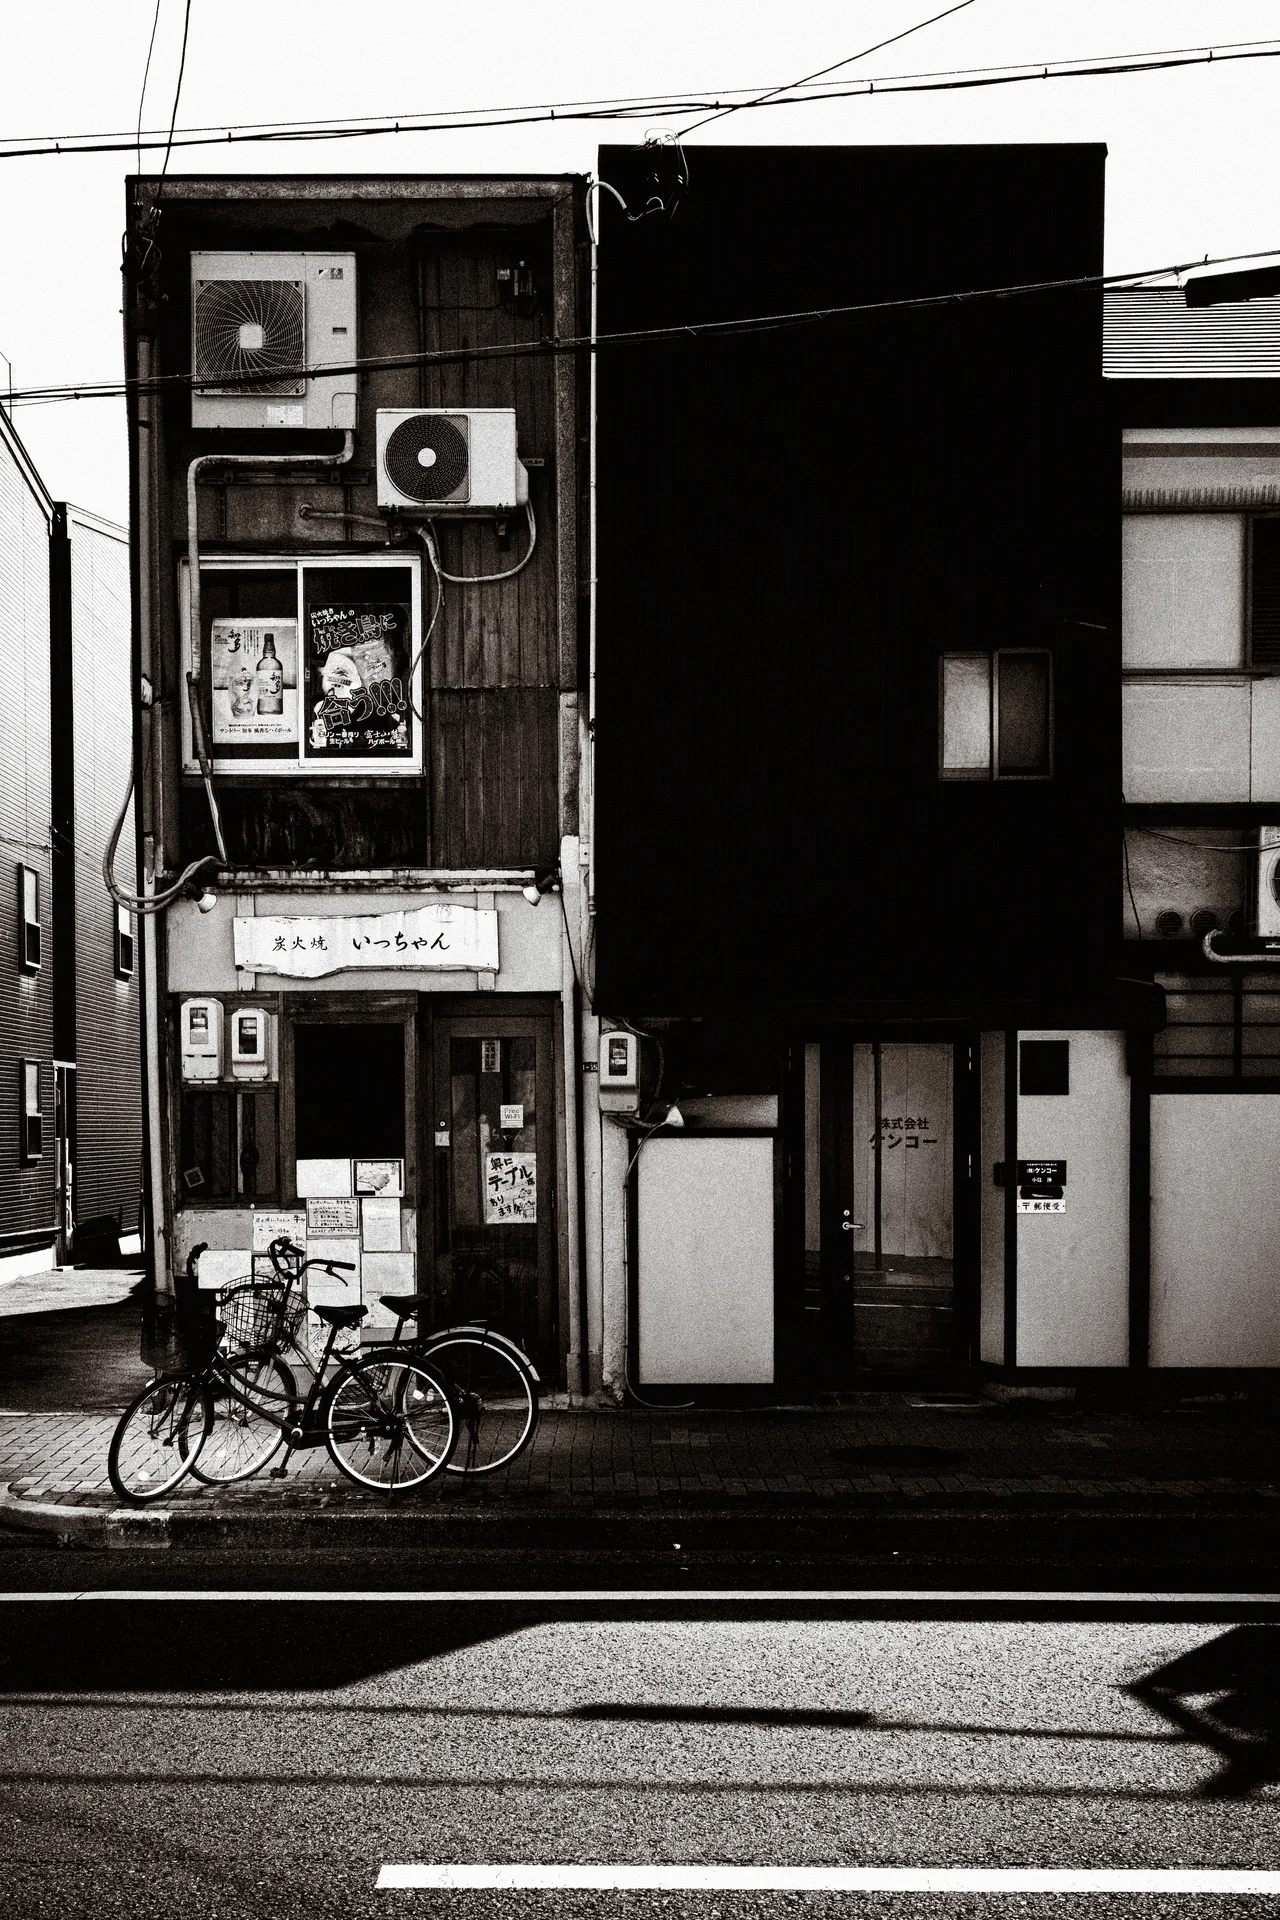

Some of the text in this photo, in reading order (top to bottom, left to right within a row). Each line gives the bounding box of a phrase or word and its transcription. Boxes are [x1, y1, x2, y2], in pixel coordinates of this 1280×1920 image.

[271, 931, 451, 952] 炭火焼 いっちゃん
